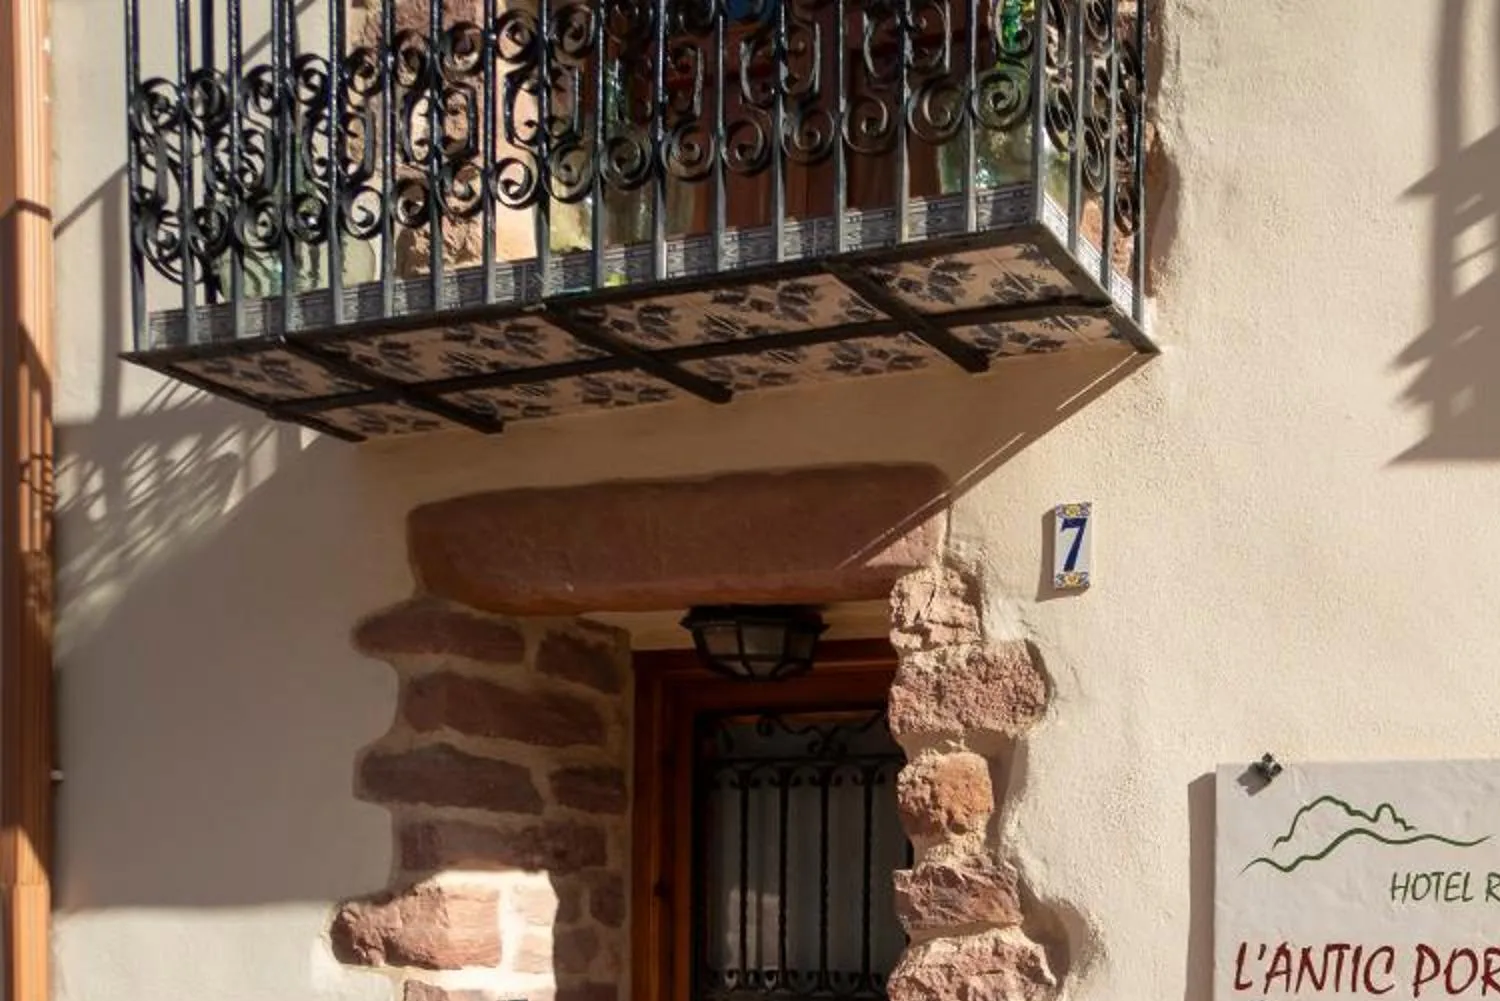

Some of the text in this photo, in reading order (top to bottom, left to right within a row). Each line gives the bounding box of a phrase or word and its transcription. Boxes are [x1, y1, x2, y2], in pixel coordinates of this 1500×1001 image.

[1061, 517, 1088, 572] 7
[1390, 871, 1474, 903] HOTEL
[1234, 941, 1395, 995] L'ANTIC
